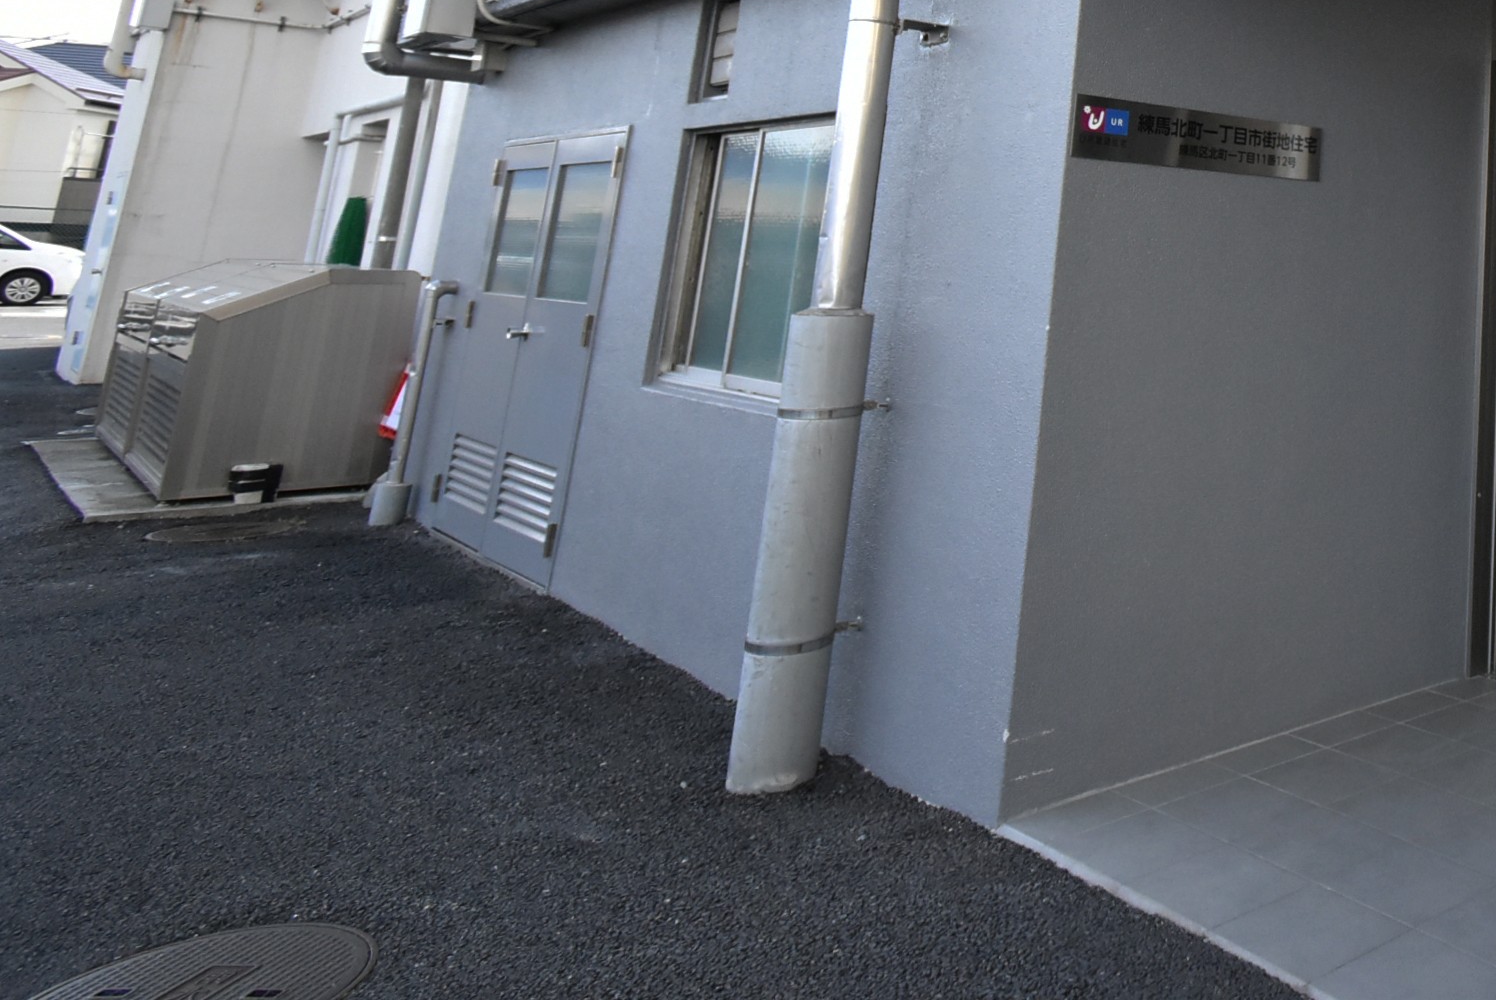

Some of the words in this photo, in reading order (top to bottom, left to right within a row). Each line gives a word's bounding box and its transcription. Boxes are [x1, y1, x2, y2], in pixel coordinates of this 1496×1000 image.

[1110, 118, 1123, 127] UR
[1138, 114, 1317, 154] 練馬北町一丁目市街地住宅
